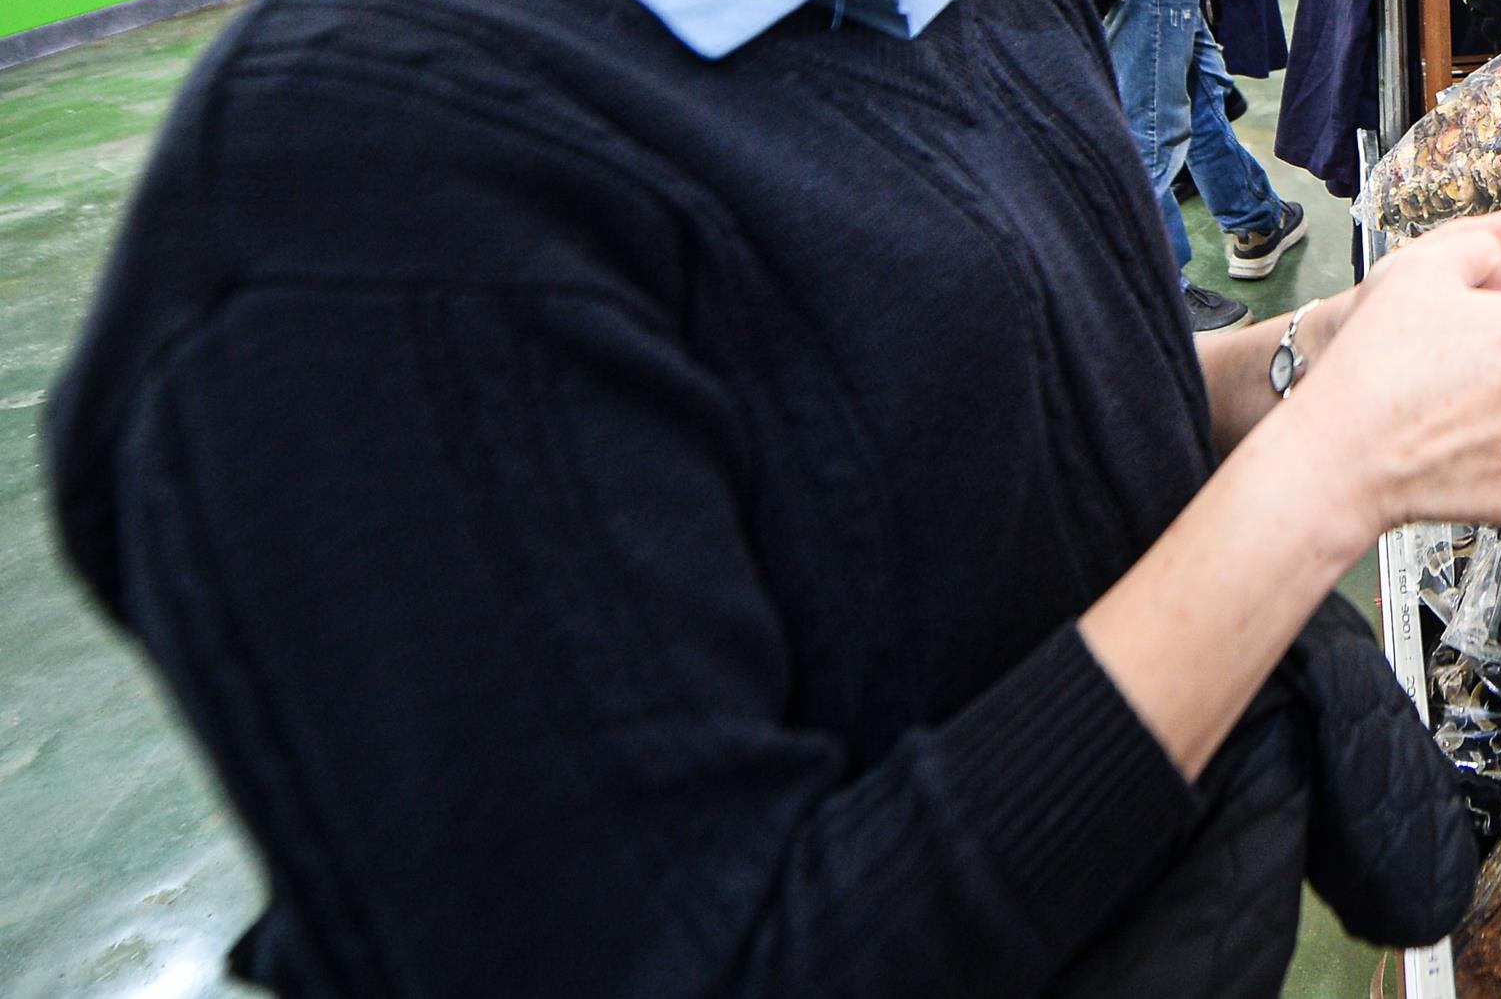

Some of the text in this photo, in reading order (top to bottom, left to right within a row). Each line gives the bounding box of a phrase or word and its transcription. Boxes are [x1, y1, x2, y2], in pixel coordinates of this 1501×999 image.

[1398, 568, 1408, 595] ISO
[1401, 603, 1412, 642] 9001
[1406, 674, 1417, 704] 20
